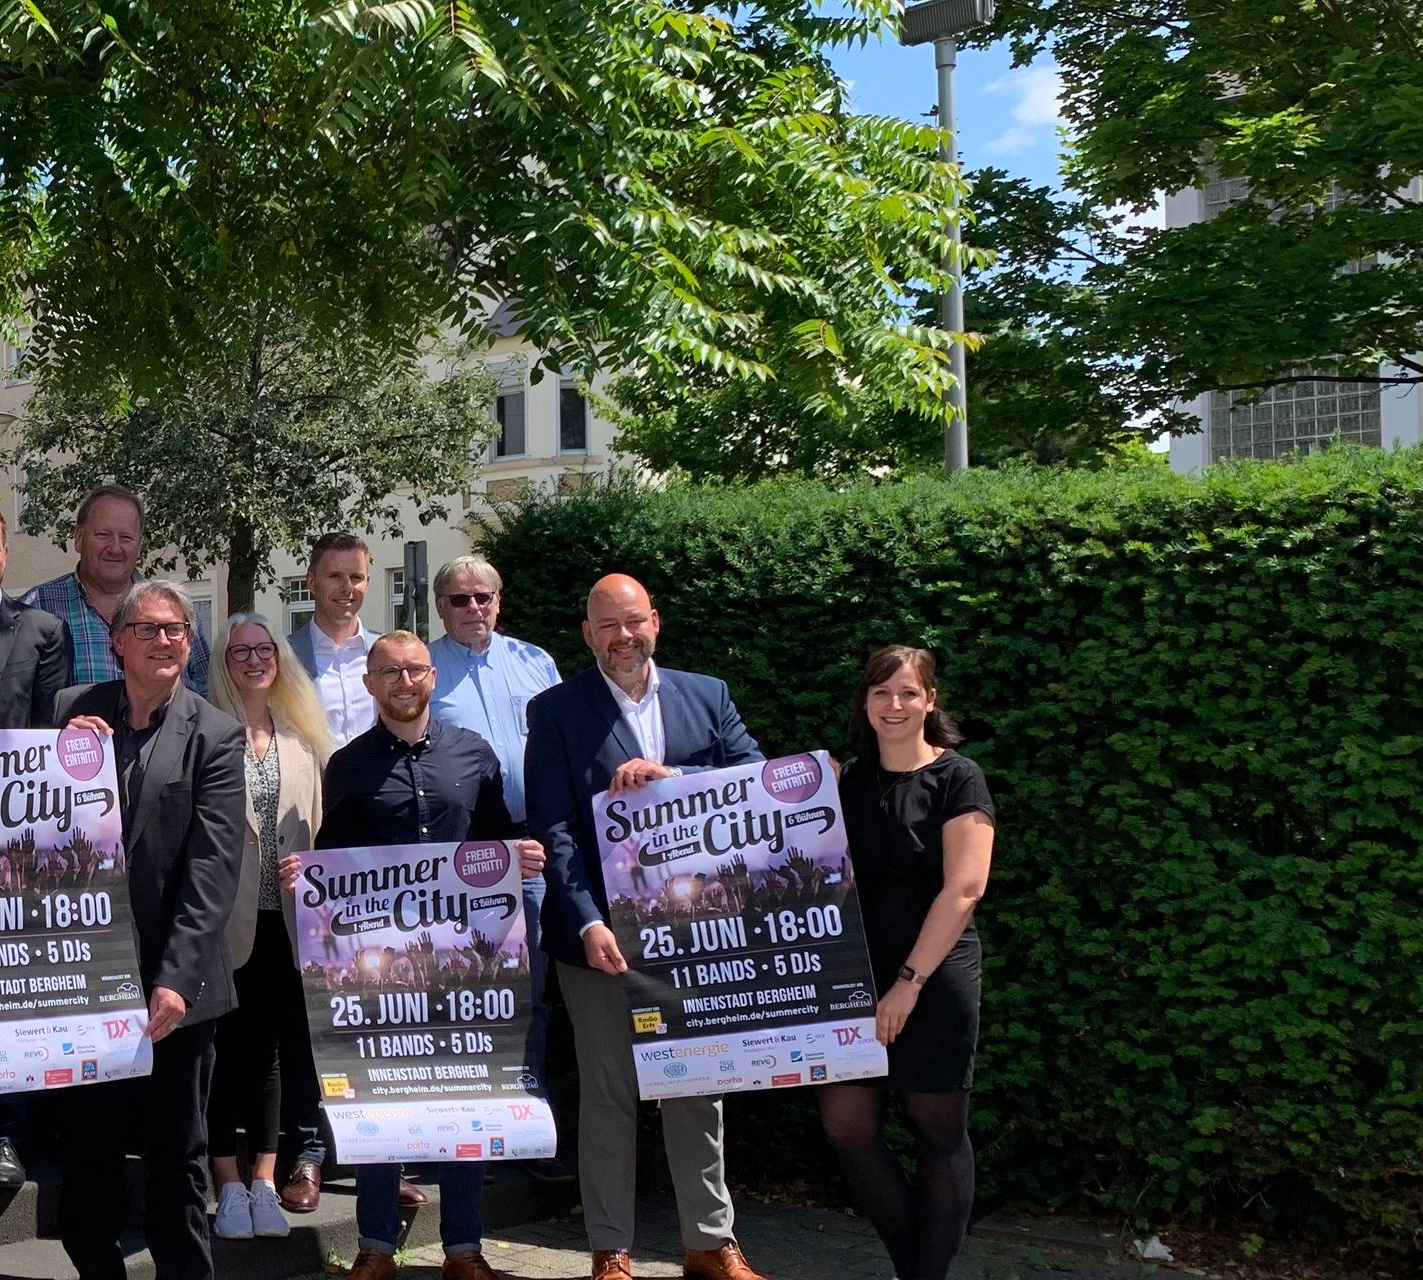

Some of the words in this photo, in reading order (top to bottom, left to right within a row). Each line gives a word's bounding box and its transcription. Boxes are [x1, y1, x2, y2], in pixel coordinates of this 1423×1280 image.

[65, 738, 90, 752] FREIER
[65, 752, 98, 767] EINTRITT!
[772, 762, 806, 779] FREIER
[772, 774, 816, 793] EINTRITT!
[0, 780, 72, 832] City
[77, 794, 82, 803] 6
[606, 776, 755, 843] Summer
[788, 816, 794, 825] 6
[795, 810, 825, 824] Bühnen
[652, 833, 669, 848] in
[673, 823, 699, 841] the
[703, 810, 784, 856] City
[466, 848, 496, 862] FREIER
[462, 860, 503, 876] EINTRITT!
[303, 856, 447, 908] Summer
[42, 892, 111, 928] 18:00
[346, 901, 361, 917] in
[366, 897, 389, 914] the
[394, 889, 467, 934] City
[473, 900, 478, 909] 6
[358, 918, 384, 931] Abend
[640, 926, 684, 959] 25.
[690, 916, 748, 953] JUNI
[764, 904, 843, 944] 18:00
[48, 941, 59, 963] 5
[63, 940, 91, 962] DJs
[671, 967, 692, 989] 11
[697, 958, 757, 986] BANDS
[775, 955, 786, 976] 5
[790, 952, 822, 974] DJs
[29, 974, 86, 993] BERGHEIM
[330, 996, 371, 1027] 25.
[377, 993, 428, 1025] JUNI
[446, 989, 514, 1021] 18:00
[682, 992, 753, 1013] INNENSTADT
[756, 984, 817, 1005] BERGHEIM
[830, 1001, 871, 1011] BERGHEIM
[686, 1004, 819, 1028] city.bergheim.de/summercity
[357, 1037, 376, 1058] 11
[380, 1034, 435, 1057] BANDS
[451, 1033, 462, 1054] 5
[466, 1032, 493, 1053] DJs
[742, 1036, 773, 1047] Siewert
[781, 1034, 797, 1043] Kau
[641, 1041, 729, 1062] westenergie
[368, 1066, 432, 1082] INNENSTADT
[435, 1065, 489, 1080] BERGHEIM
[372, 1083, 492, 1096] city.bergheim.de/summercity
